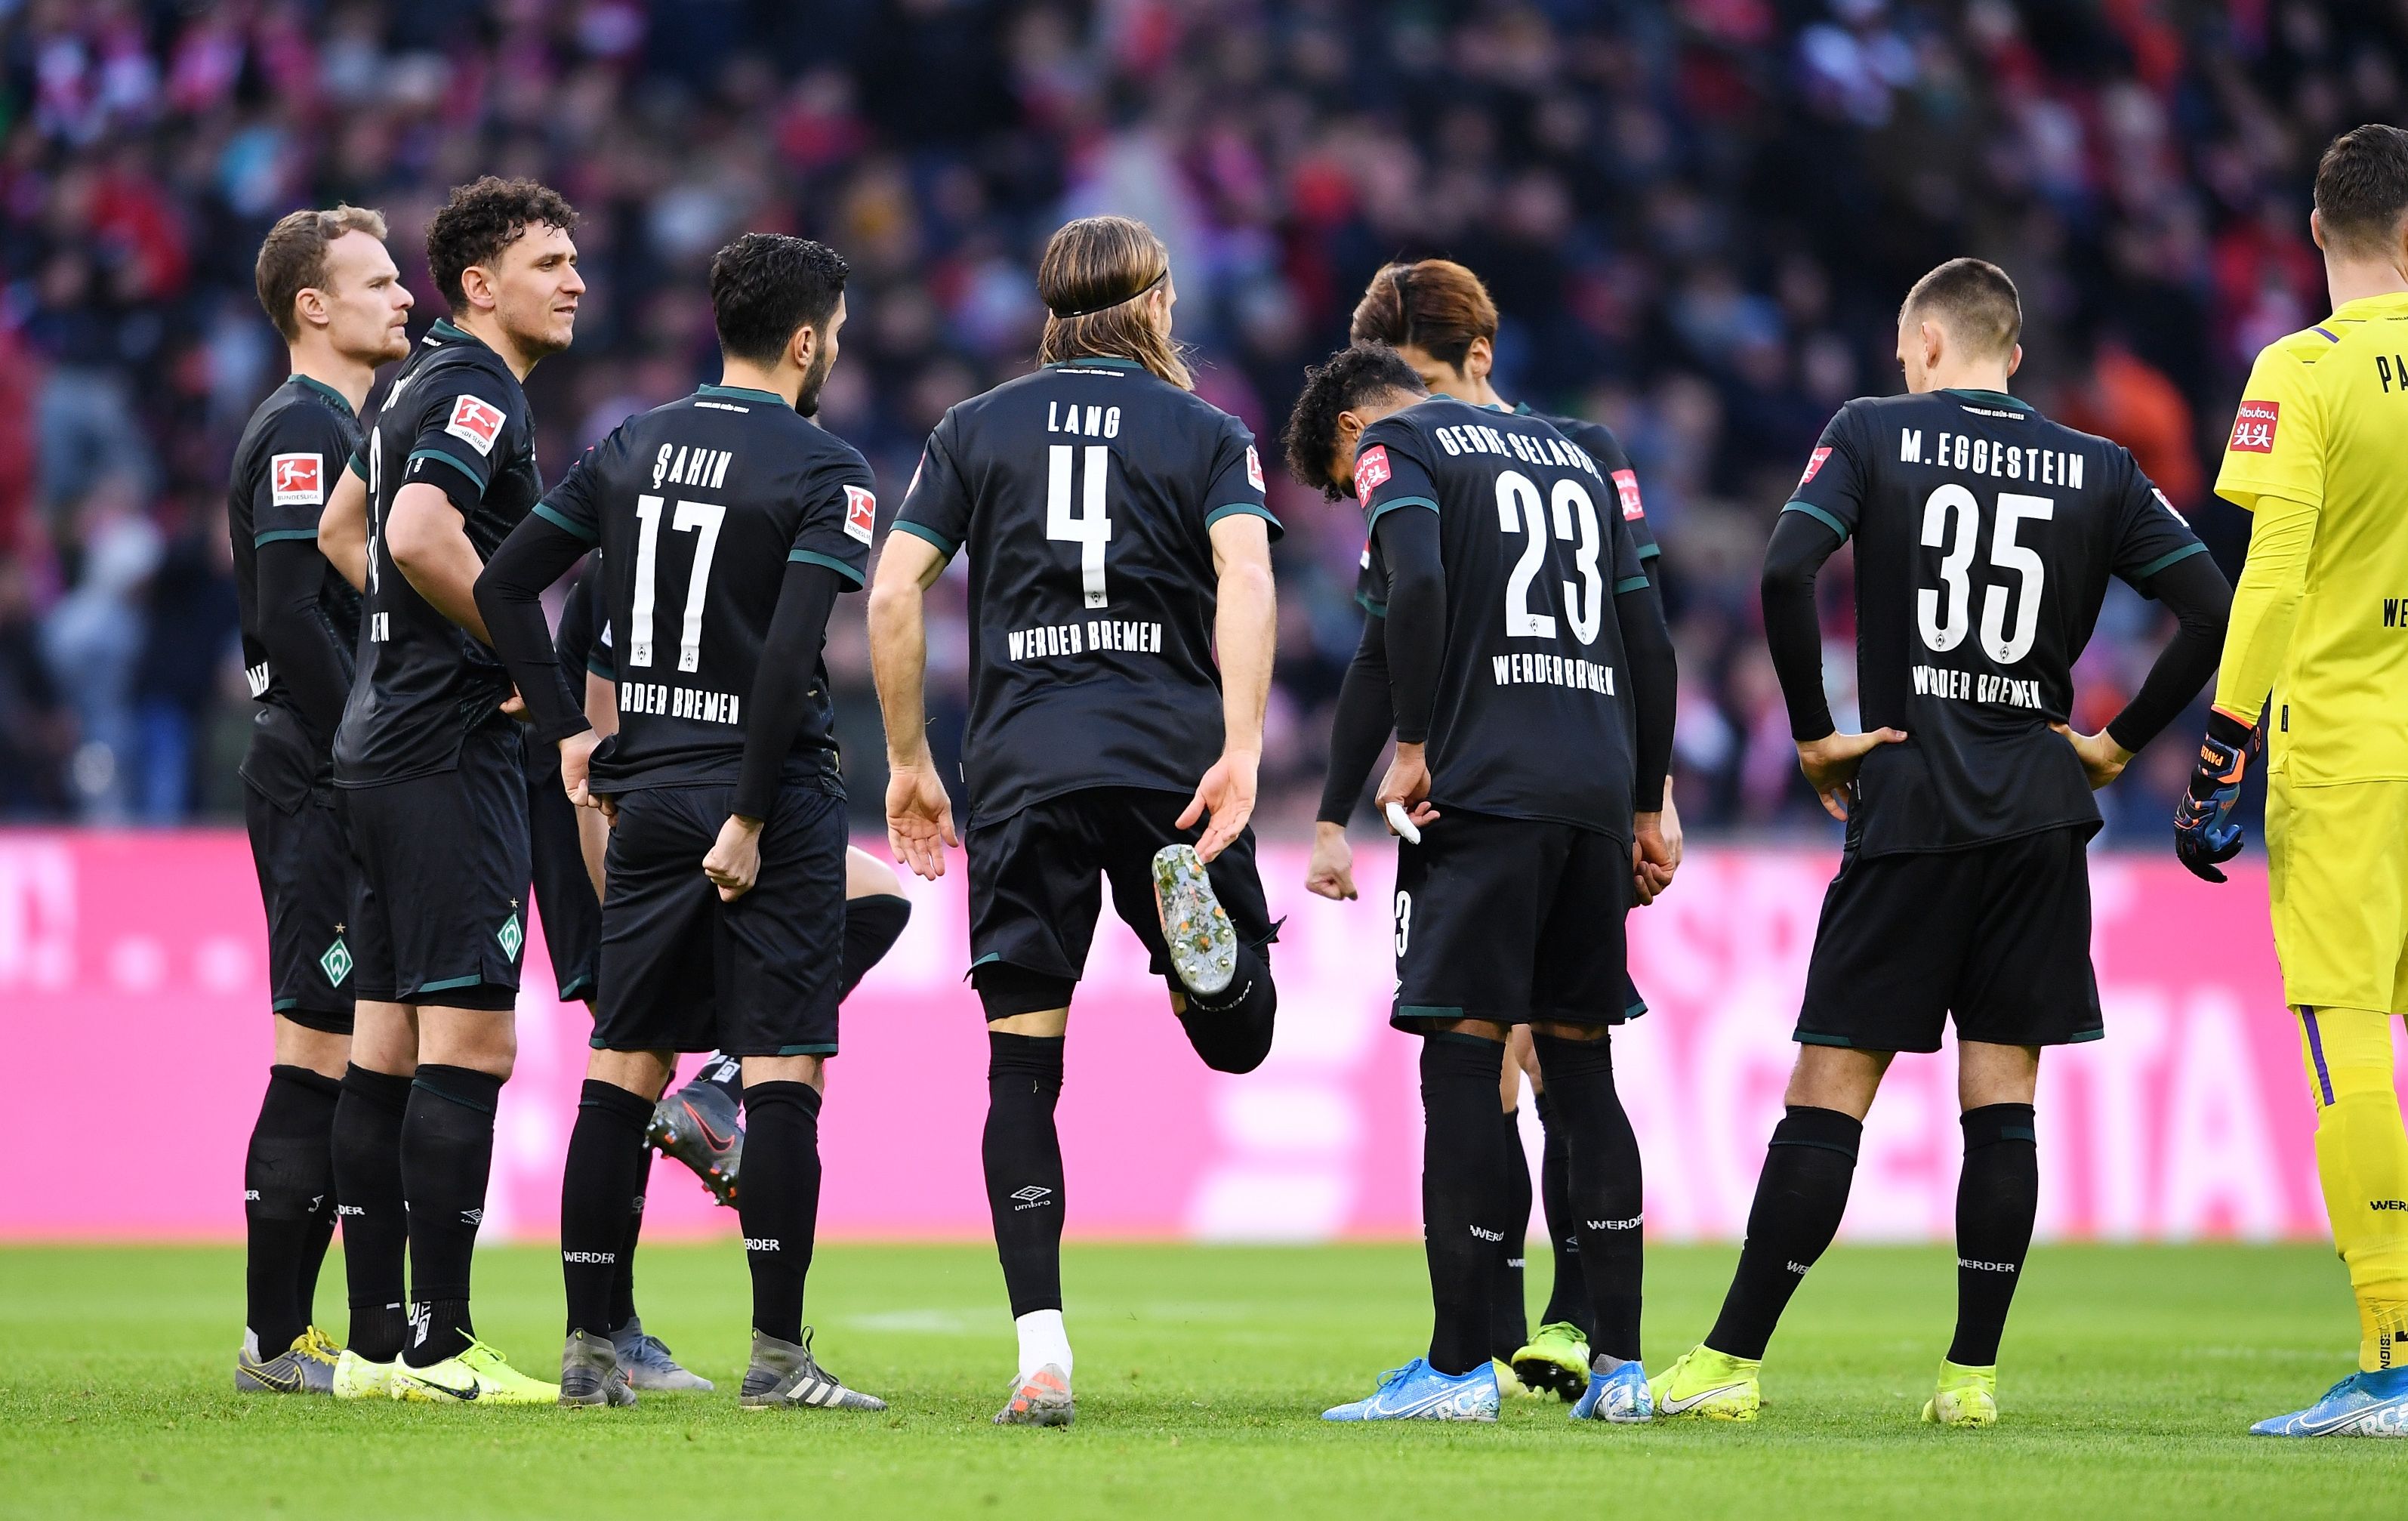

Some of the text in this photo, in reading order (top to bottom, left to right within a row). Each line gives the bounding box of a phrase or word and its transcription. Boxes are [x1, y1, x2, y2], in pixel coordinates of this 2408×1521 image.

[1048, 401, 1121, 439] LANG
[652, 443, 732, 489] ŞAHIN
[1435, 425, 1604, 484] GEBRE SELASS
[1046, 445, 1112, 608] 4
[1495, 470, 1602, 646] 23
[1916, 483, 2054, 665] 35
[630, 495, 726, 672] 17
[1008, 620, 1162, 661] WERDER BREMEN
[1492, 653, 1563, 685] WERDER
[672, 687, 739, 725] BREMEN
[1977, 674, 2042, 709] BREMEN
[1015, 1200, 1051, 1211] umbro
[563, 1251, 615, 1263] WERDER
